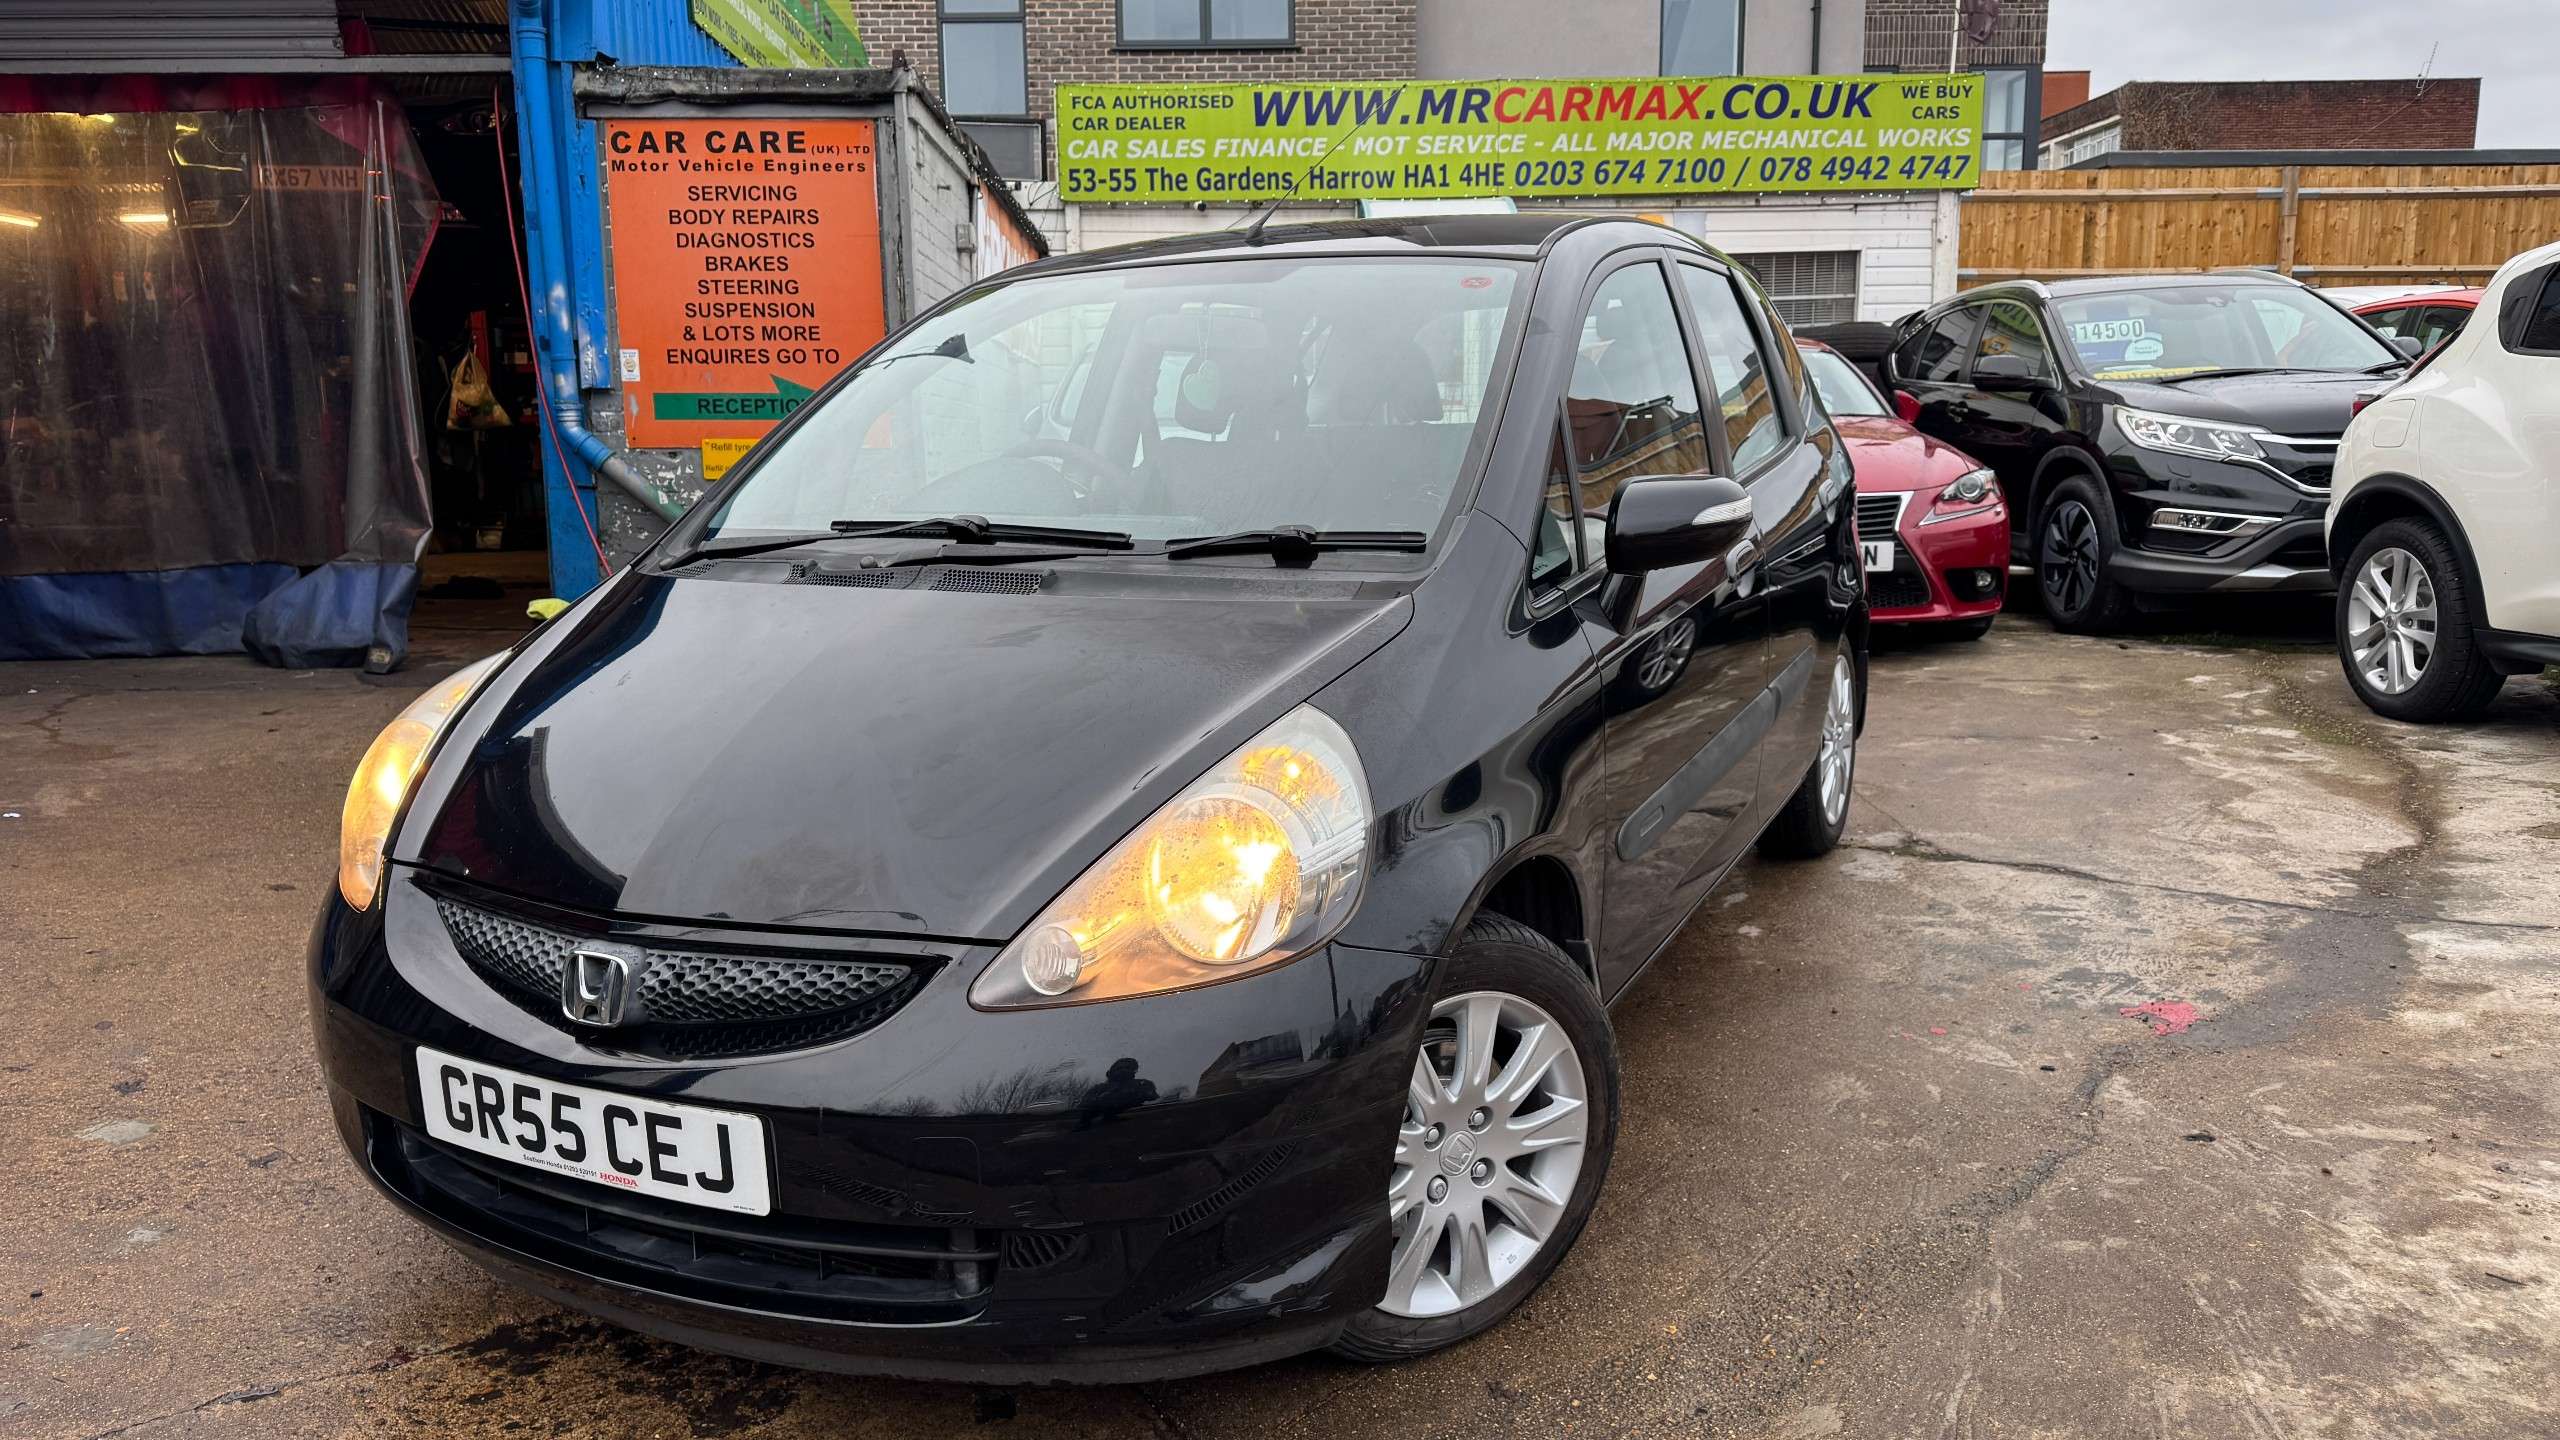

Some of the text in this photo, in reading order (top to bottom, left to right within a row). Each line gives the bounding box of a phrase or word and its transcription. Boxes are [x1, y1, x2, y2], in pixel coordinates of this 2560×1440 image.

[1902, 85, 1972, 98] WE BUY
[1072, 95, 1234, 109] FCA AUTHORISED
[1253, 84, 1879, 126] WWW.MRCARMAX.CO.UK
[1912, 106, 1959, 120] CARS
[1073, 116, 1186, 130] CAR DEALER
[610, 130, 870, 155] CAR CARE (UK) LTD
[1067, 139, 1119, 159] CAR
[1126, 139, 1206, 158] SALES
[1213, 137, 1327, 158] FINANCE
[1353, 136, 1409, 156] MOT
[1415, 135, 1526, 155] SERVICE
[1552, 134, 1596, 152] ALL
[1606, 131, 1695, 151] MAJOR
[1701, 130, 1867, 150] MECHANICAL
[1877, 128, 1970, 148] WORKS
[611, 159, 866, 175] Motor Vehicle Engineers
[1068, 155, 1971, 195] 53-55 The Gardens, Harrow HA1 4HE 0203 674 7100 / 078 4942 4747
[318, 168, 358, 188] VNH
[688, 185, 798, 201] SERVICING
[669, 209, 819, 225] BODY REPAIRS
[676, 232, 815, 248] DIAGNOSTICS
[705, 256, 789, 271] BRAKES
[697, 279, 799, 295] STEERING
[685, 302, 815, 318] SUSPENSION
[683, 325, 821, 341] & LOTS MORE
[2080, 320, 2143, 340] 14500
[667, 349, 840, 366] ENQUIRES GO TO
[698, 398, 804, 414] RECEPTIO
[1860, 545, 1877, 566] N
[440, 1064, 734, 1194] GR55 CEJ
[600, 1172, 638, 1187] HONDA
